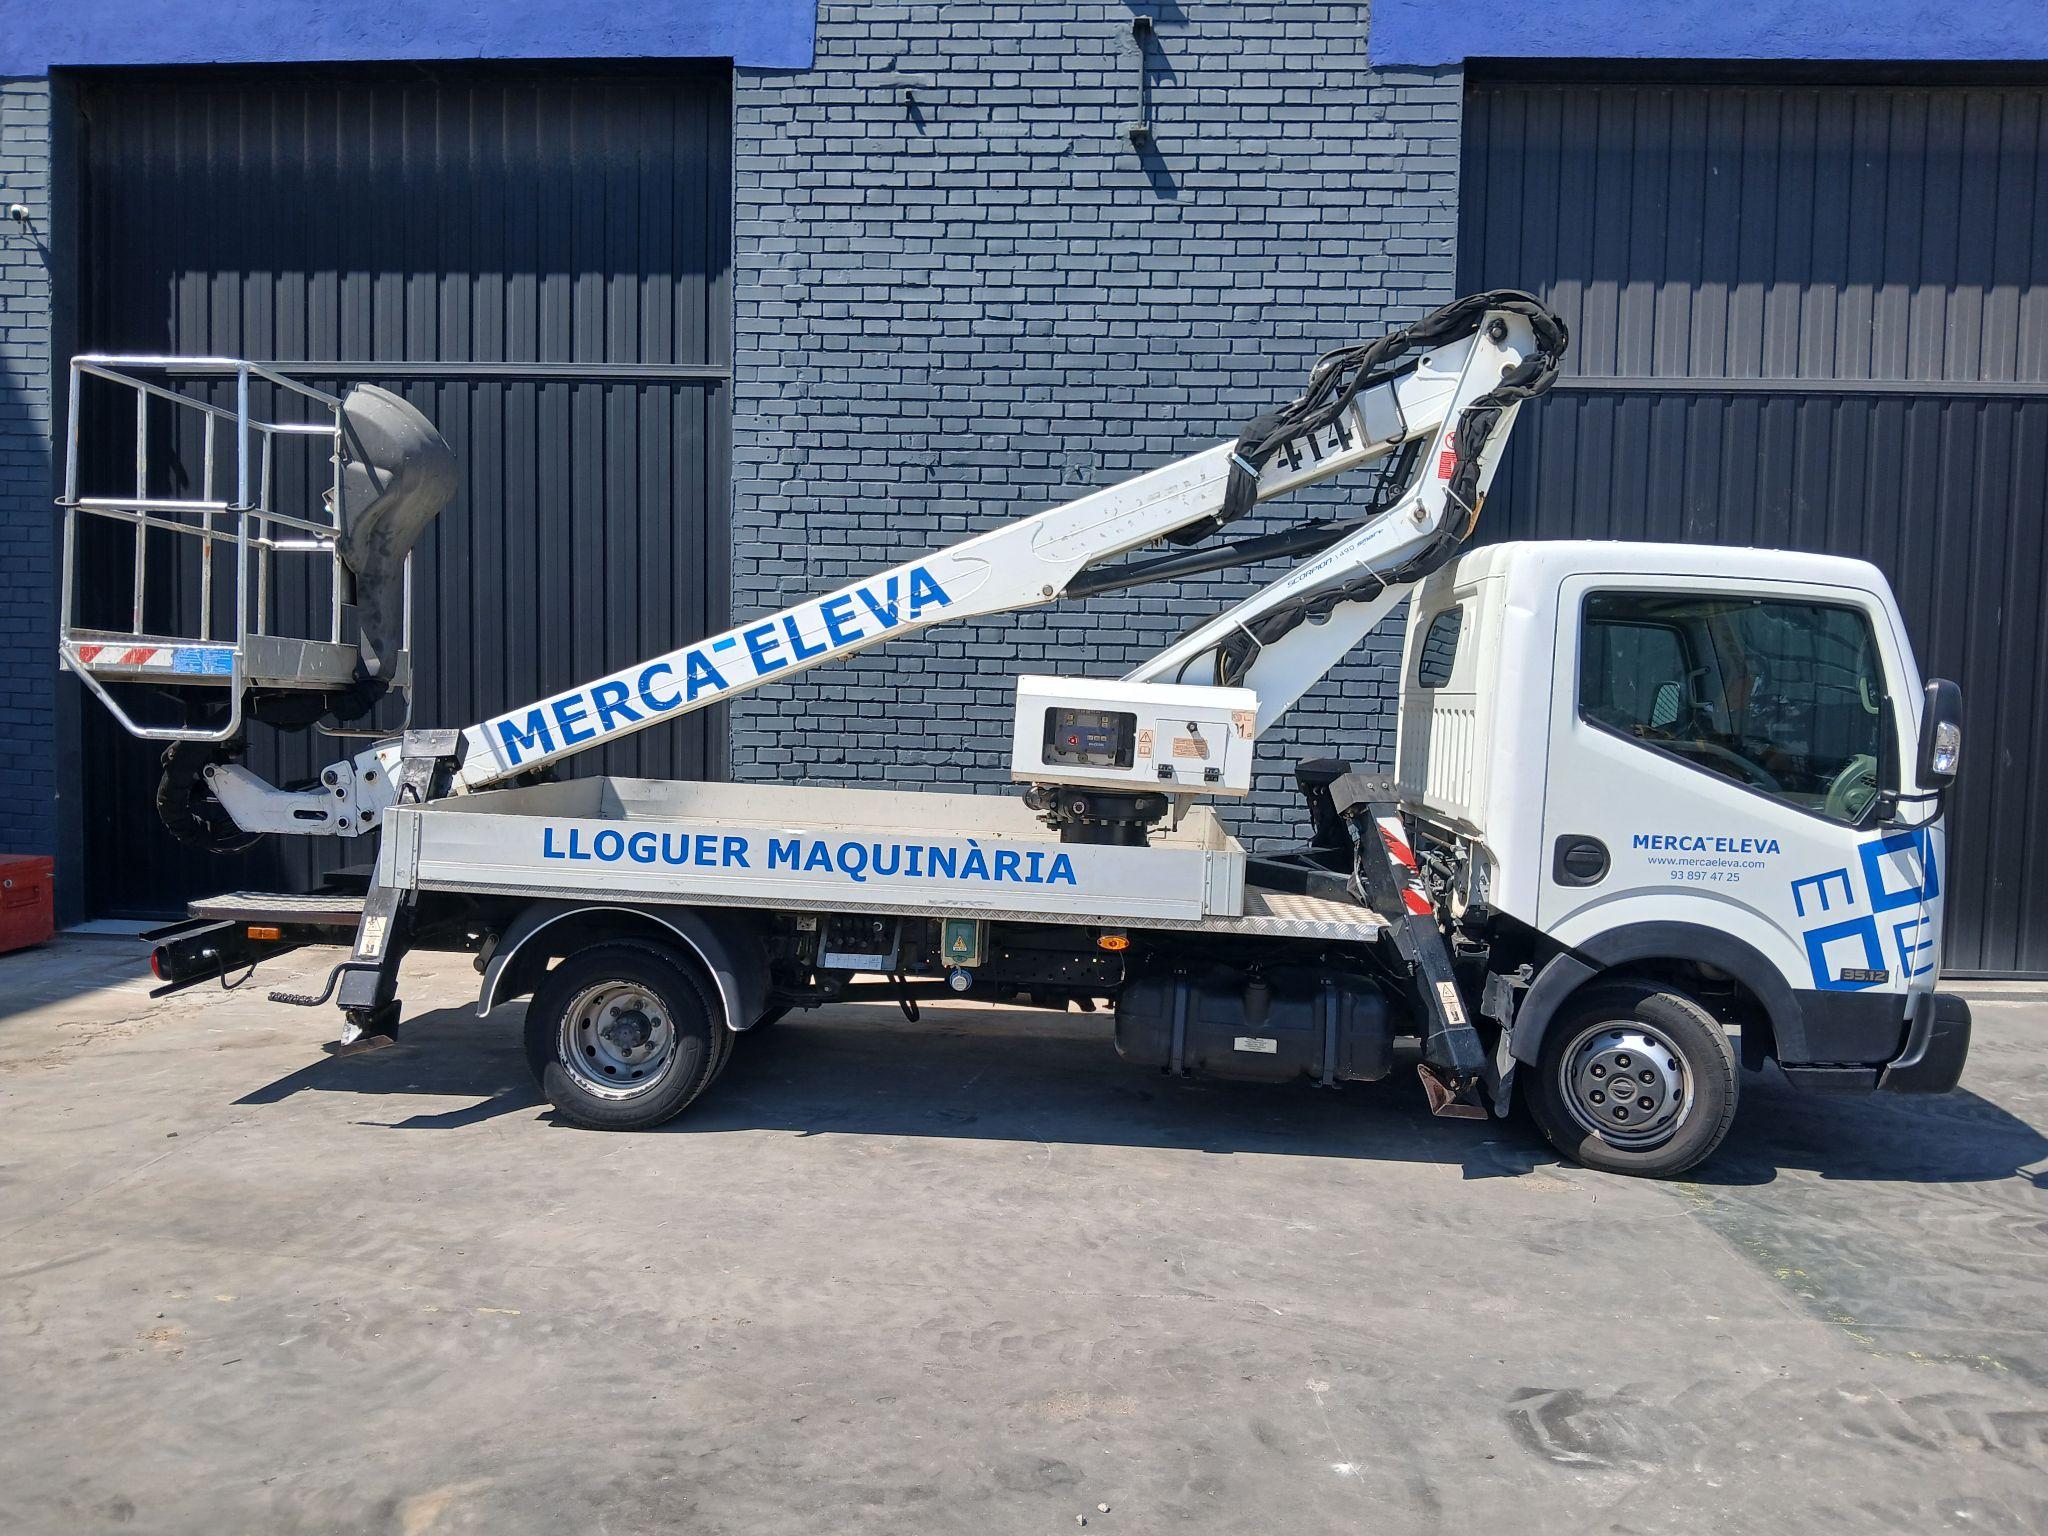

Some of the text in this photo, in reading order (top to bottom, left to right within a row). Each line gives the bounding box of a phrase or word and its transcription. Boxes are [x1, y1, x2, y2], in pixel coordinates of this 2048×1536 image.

[542, 827, 1078, 885] LLOGUER MAQUINÀRIA
[1647, 856, 1766, 869] www.mercaeleva.com
[1670, 870, 1740, 882] 93 897 47 25
[1842, 968, 1887, 982] 35.12
